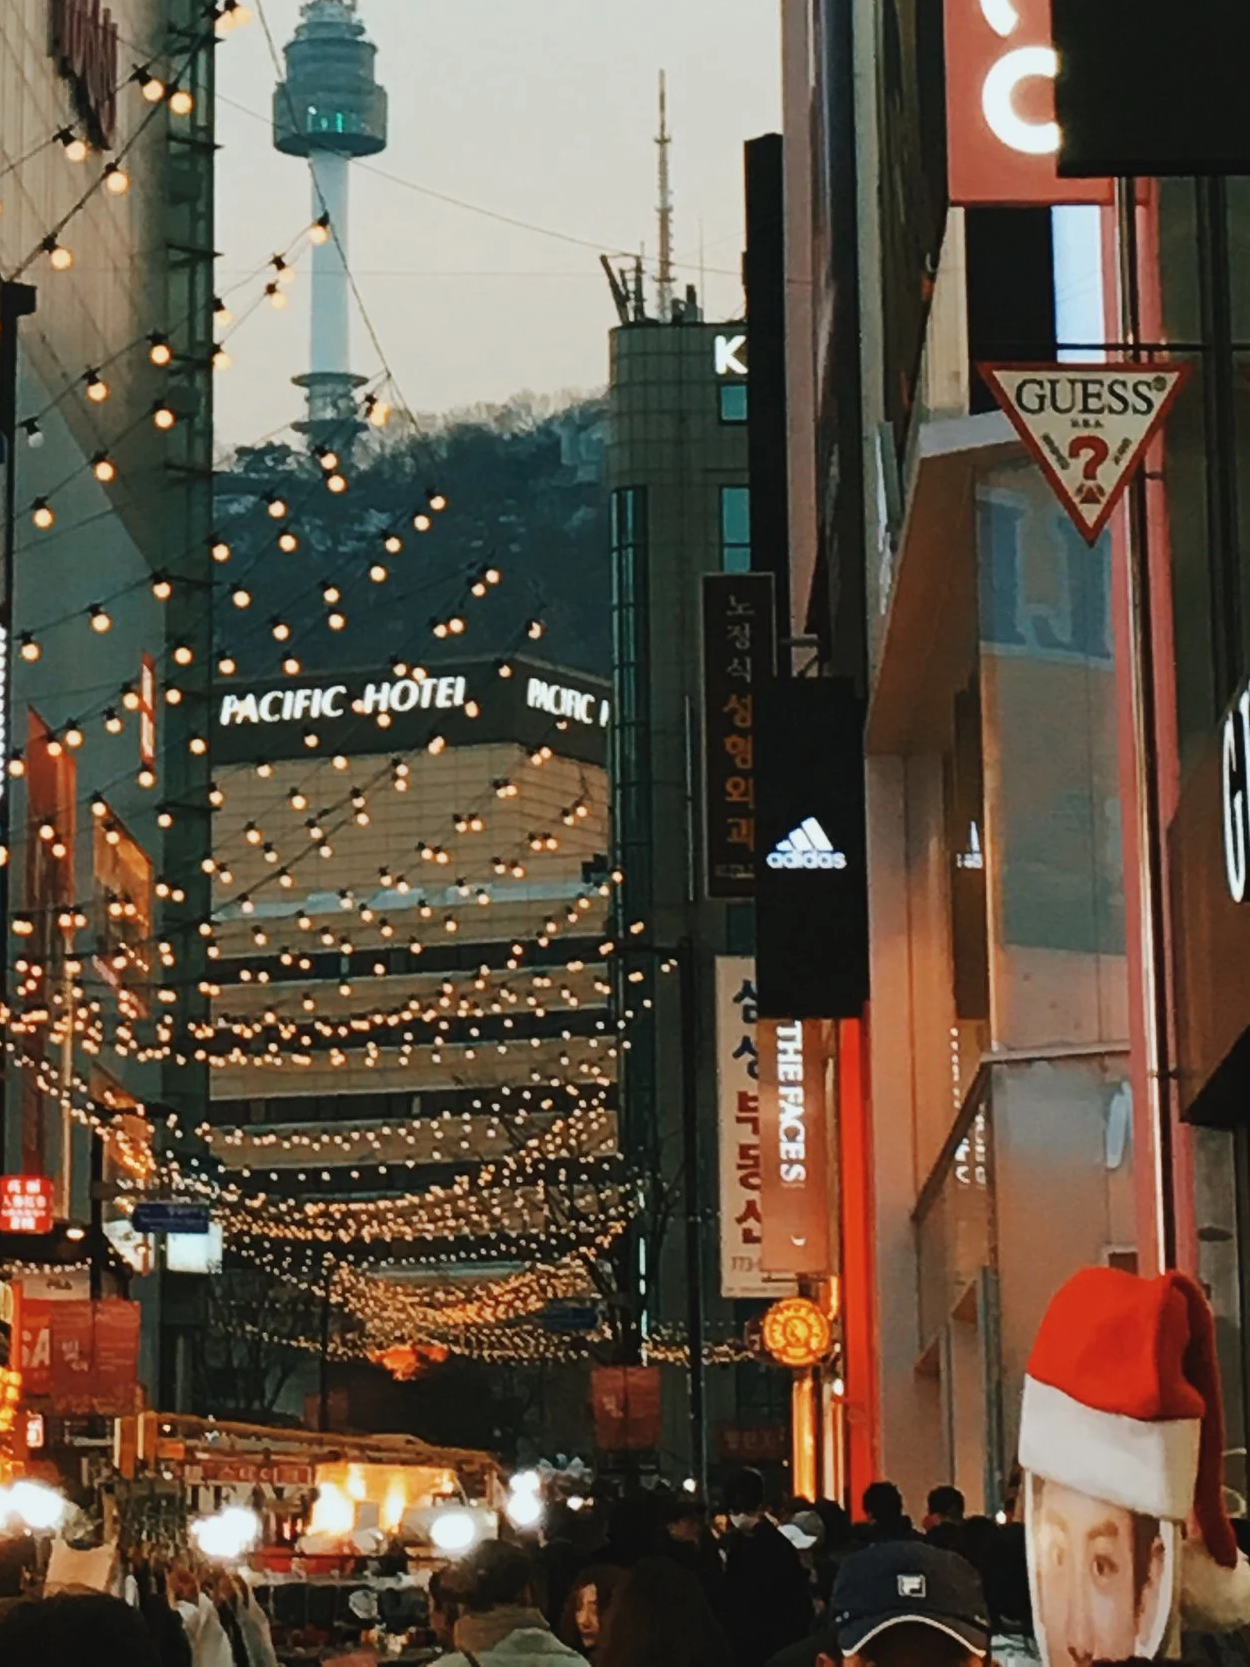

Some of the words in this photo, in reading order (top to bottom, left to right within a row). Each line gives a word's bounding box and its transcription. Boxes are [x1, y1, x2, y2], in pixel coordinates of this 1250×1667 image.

[714, 336, 748, 374] K
[1014, 378, 1155, 416] GUESS
[220, 686, 347, 726] PACIFIC
[363, 676, 466, 714] HOTEL
[527, 678, 595, 725] PACIFIC
[766, 851, 847, 870] adidas
